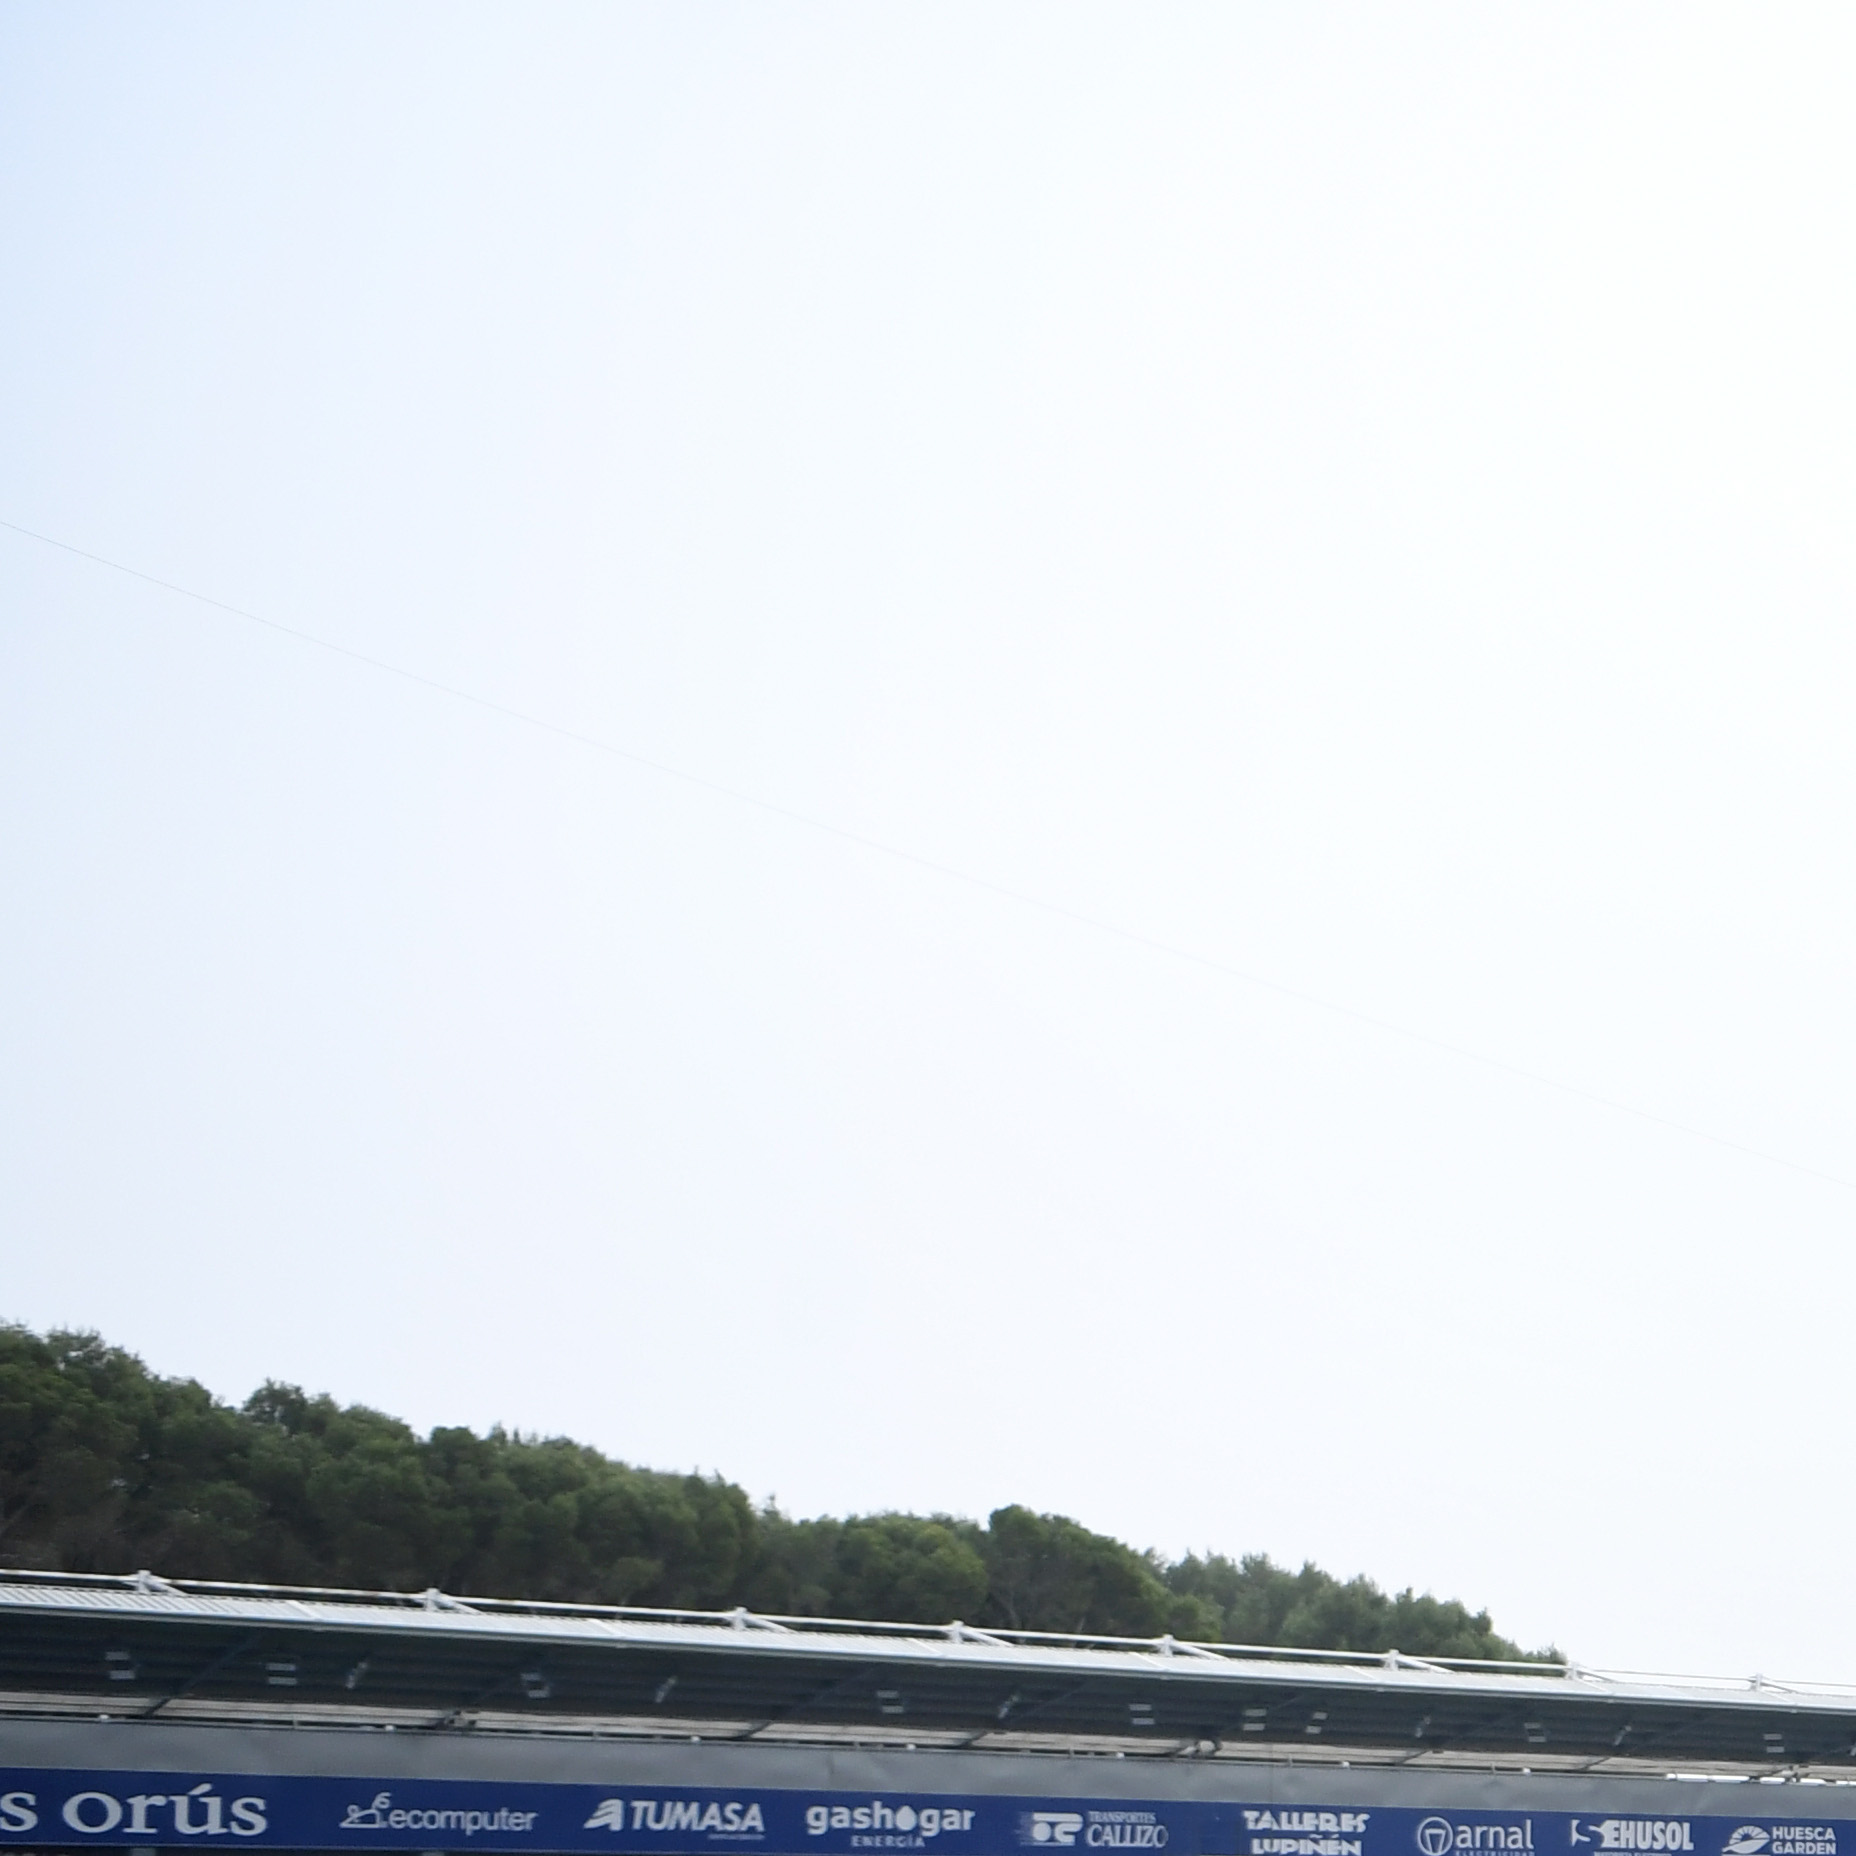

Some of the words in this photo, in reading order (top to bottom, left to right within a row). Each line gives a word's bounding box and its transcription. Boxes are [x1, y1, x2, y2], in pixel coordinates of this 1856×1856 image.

[62, 1784, 268, 1836] orús
[389, 1806, 539, 1836] ecomputer
[631, 1800, 765, 1832] TUMASA
[1088, 1810, 1156, 1824] TRANSPORTES
[1242, 1810, 1370, 1833] TALLERES
[1086, 1824, 1169, 1848] CALLIZO
[1251, 1832, 1362, 1856] LUPIÑÉN
[1455, 1819, 1534, 1850] arnal
[1772, 1826, 1836, 1841] HUESCA
[1772, 1841, 1836, 1855] GARDEN
